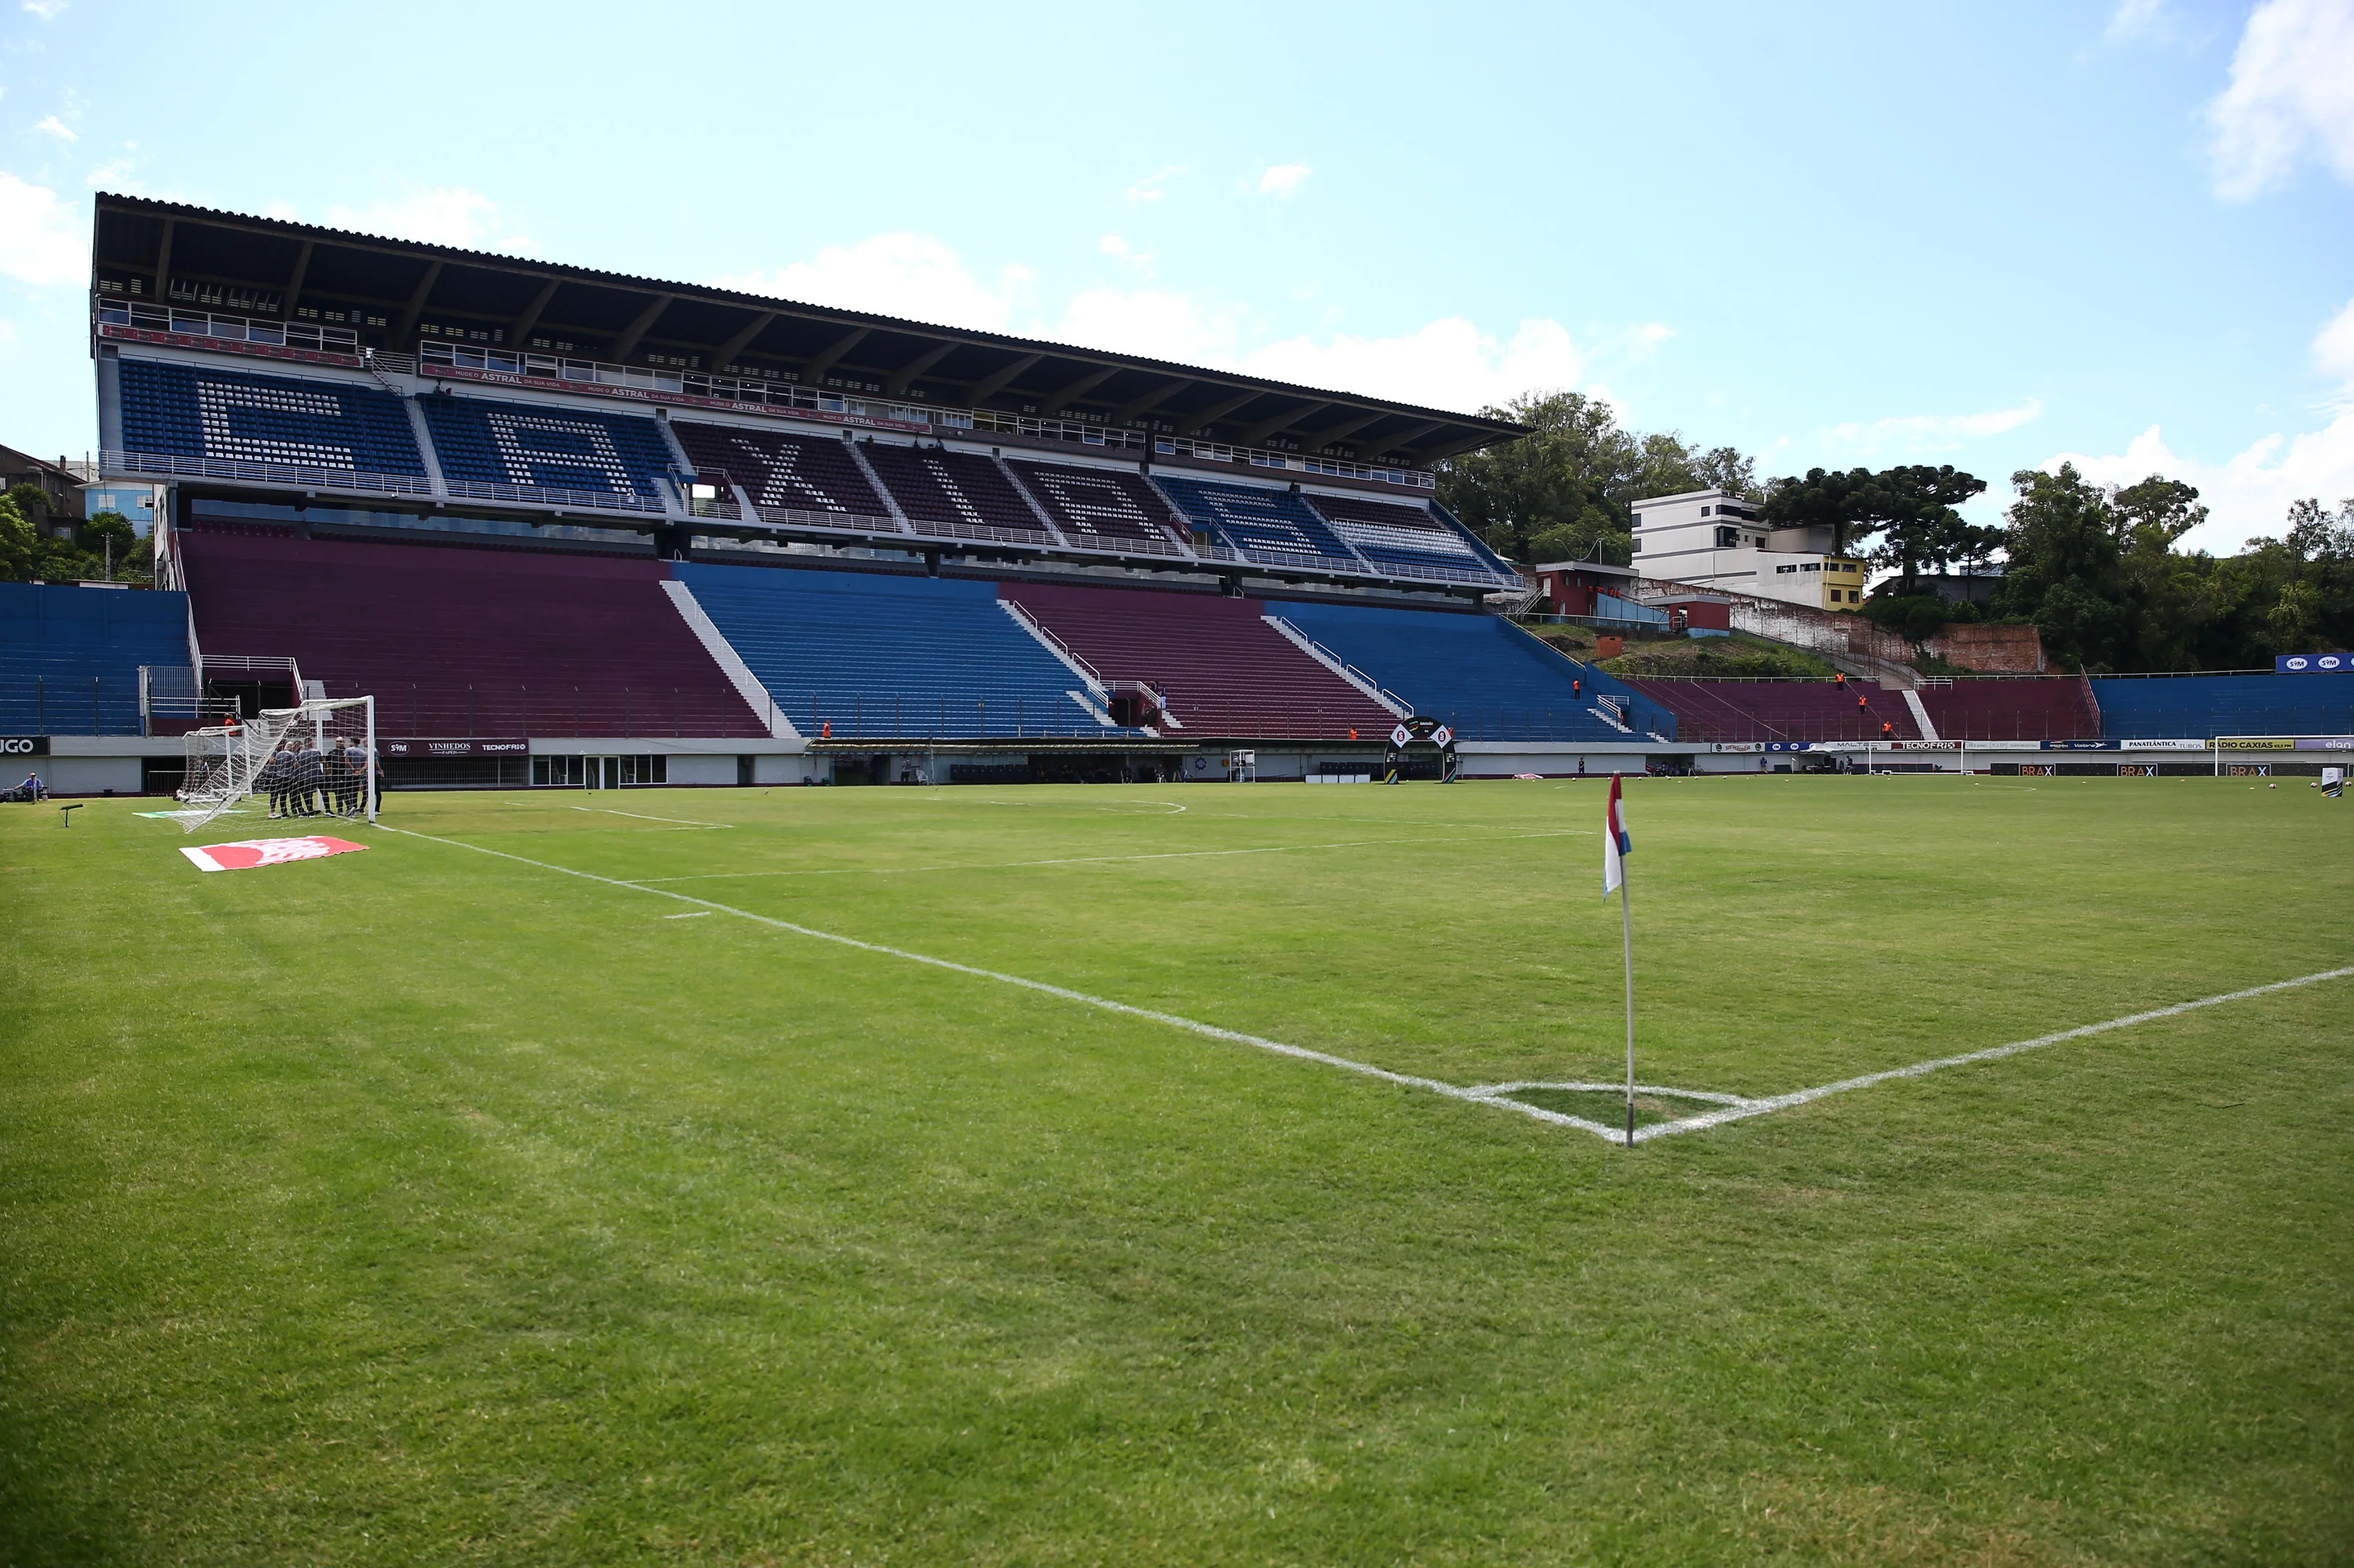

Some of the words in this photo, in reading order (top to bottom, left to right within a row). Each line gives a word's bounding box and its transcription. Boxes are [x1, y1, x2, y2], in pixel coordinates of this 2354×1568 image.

[481, 372, 522, 384] ASTRAL
[611, 388, 650, 399] ASTRAL
[732, 402, 767, 413] ASTRAL
[843, 416, 876, 426] ASTRAL
[0, 739, 33, 753] GO
[2022, 766, 2053, 776] BRAX
[2120, 766, 2154, 777] BRAX
[2230, 766, 2267, 776] BRAX
